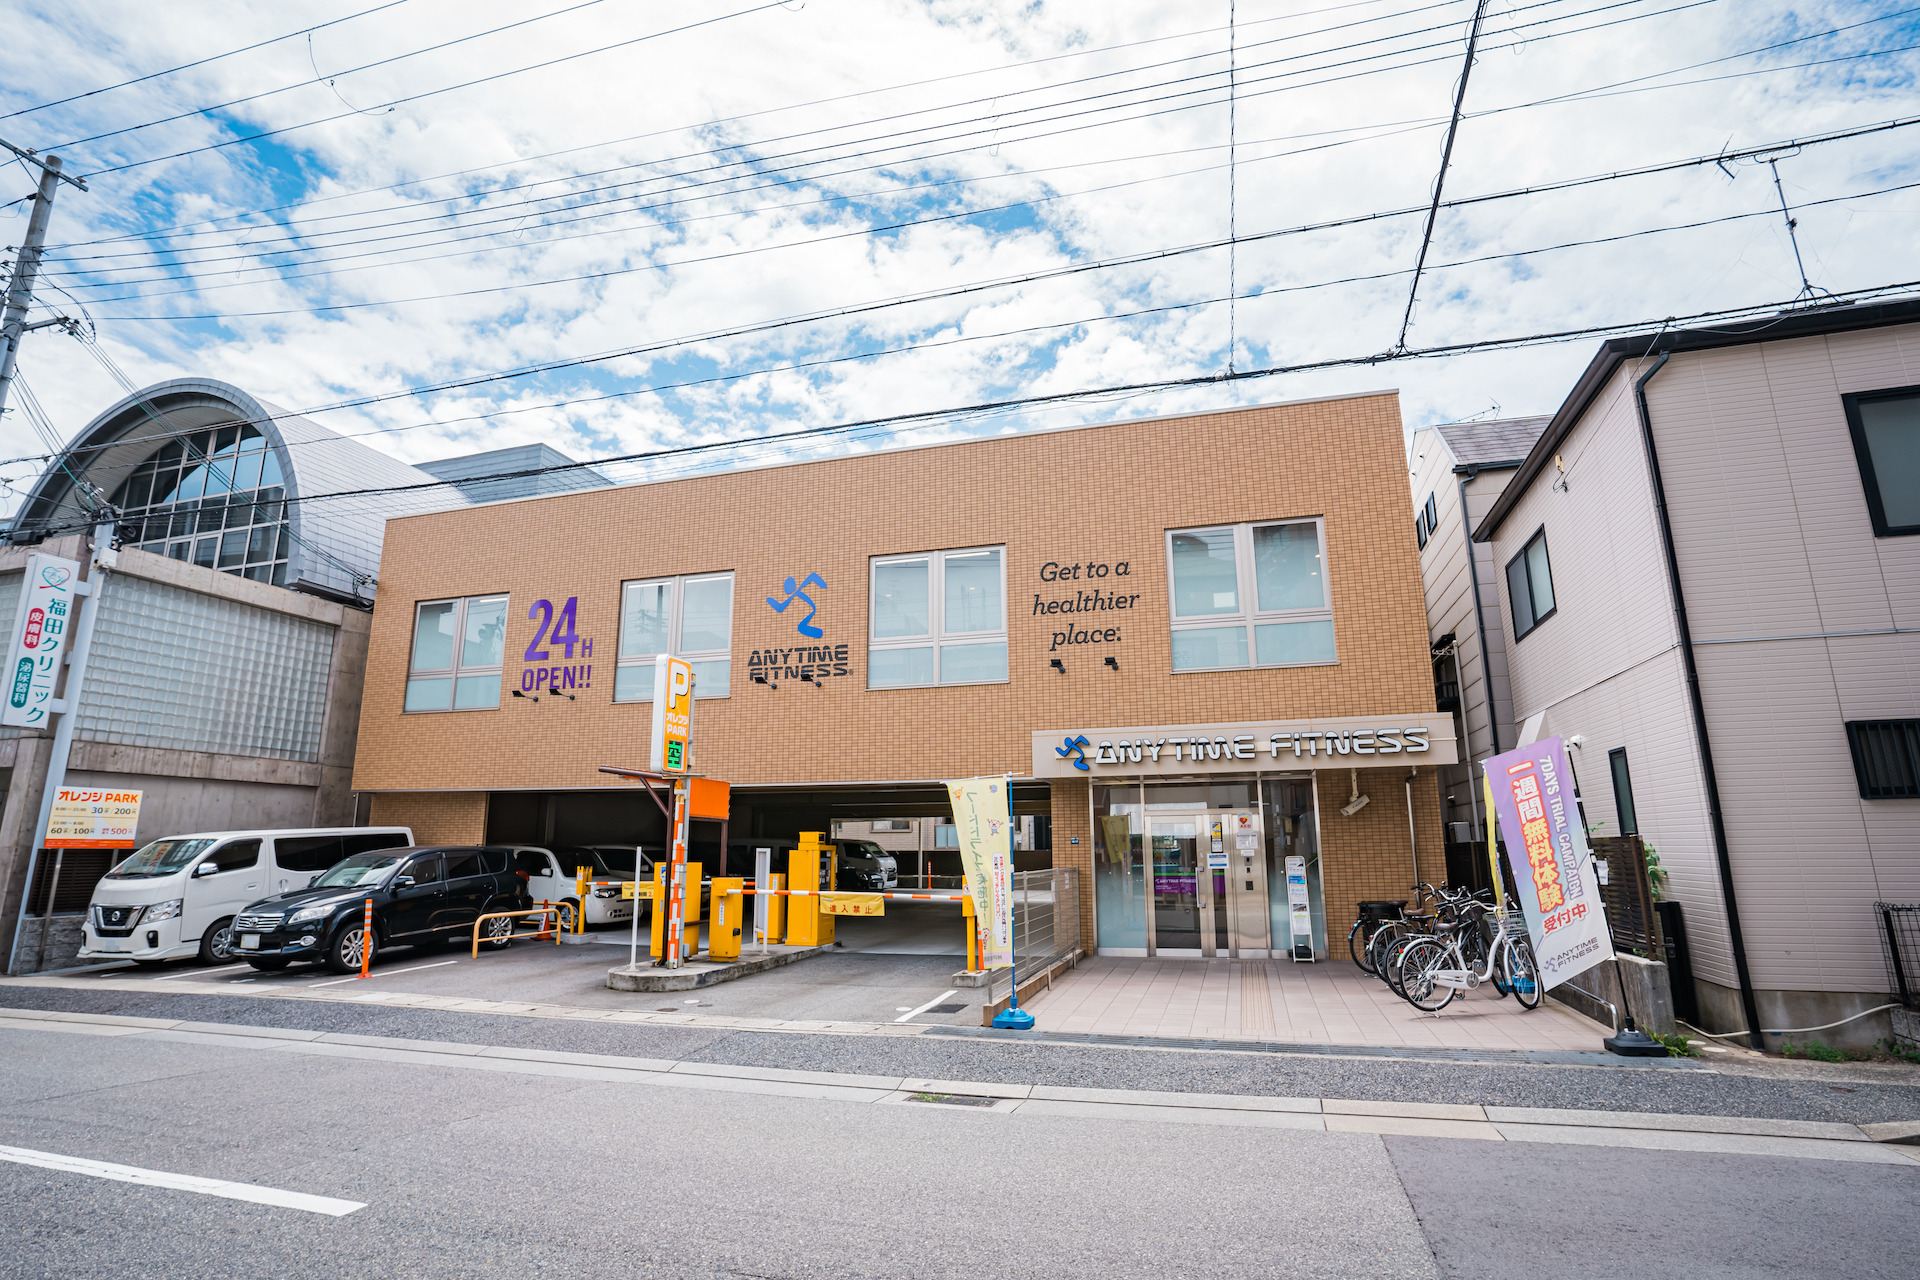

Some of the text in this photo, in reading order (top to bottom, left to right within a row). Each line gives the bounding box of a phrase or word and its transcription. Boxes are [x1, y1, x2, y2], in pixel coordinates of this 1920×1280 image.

[1040, 562, 1131, 582] Get to a
[1033, 589, 1140, 616] healthier
[25, 611, 43, 647] 皮膚科
[26, 598, 69, 723] 福田クリニック
[748, 644, 848, 667] ANYTIME
[13, 660, 33, 704] 泌尿器科
[522, 665, 592, 692] OPEN!!
[669, 661, 690, 709] P
[666, 712, 689, 725] オレンジ
[666, 724, 687, 737] PARK
[667, 740, 683, 769] 空
[1094, 726, 1431, 764] ANYTIME FITNESS
[58, 790, 139, 803] オレンジ PARK
[1507, 760, 1565, 914] 一週間無料体験
[1539, 754, 1584, 900] 7DAYS TRIAL CAMPAIGN
[829, 904, 873, 915] 進入禁止
[1543, 903, 1588, 935] 受付中
[1556, 937, 1598, 960] ANYTIME
[1557, 943, 1600, 969] FITNESS
